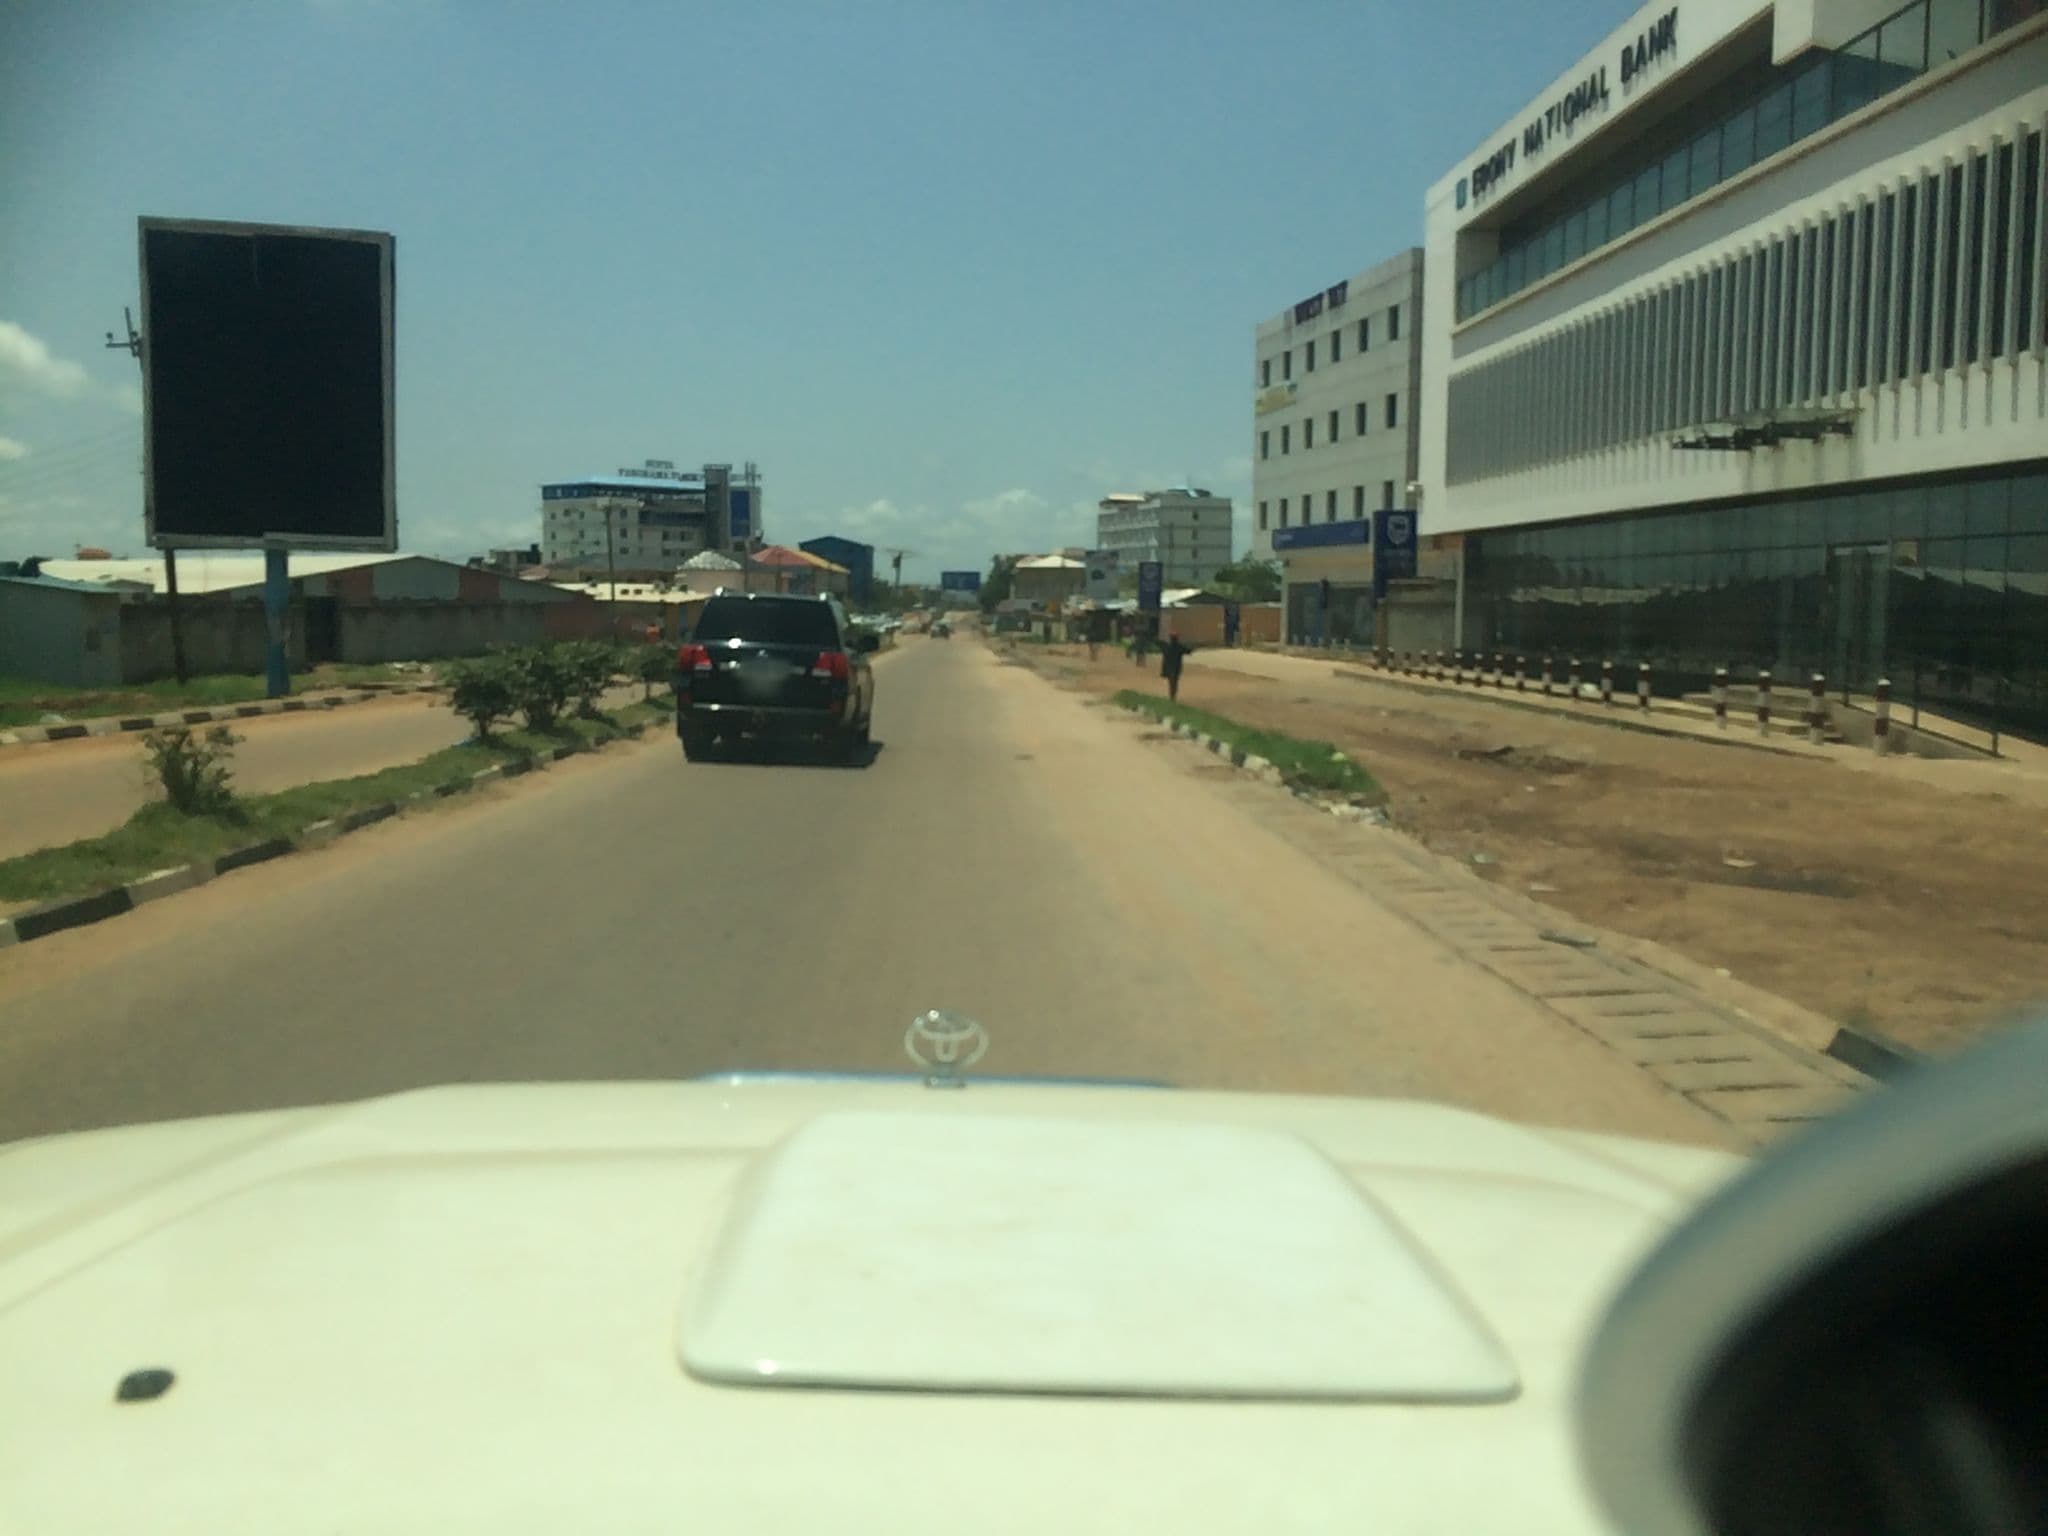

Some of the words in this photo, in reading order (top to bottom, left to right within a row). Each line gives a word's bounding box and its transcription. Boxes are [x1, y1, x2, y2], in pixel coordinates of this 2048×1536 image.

[1471, 136, 1517, 199] EBONY
[1523, 64, 1610, 158] NATIONAL
[1620, 6, 1678, 84] BANK
